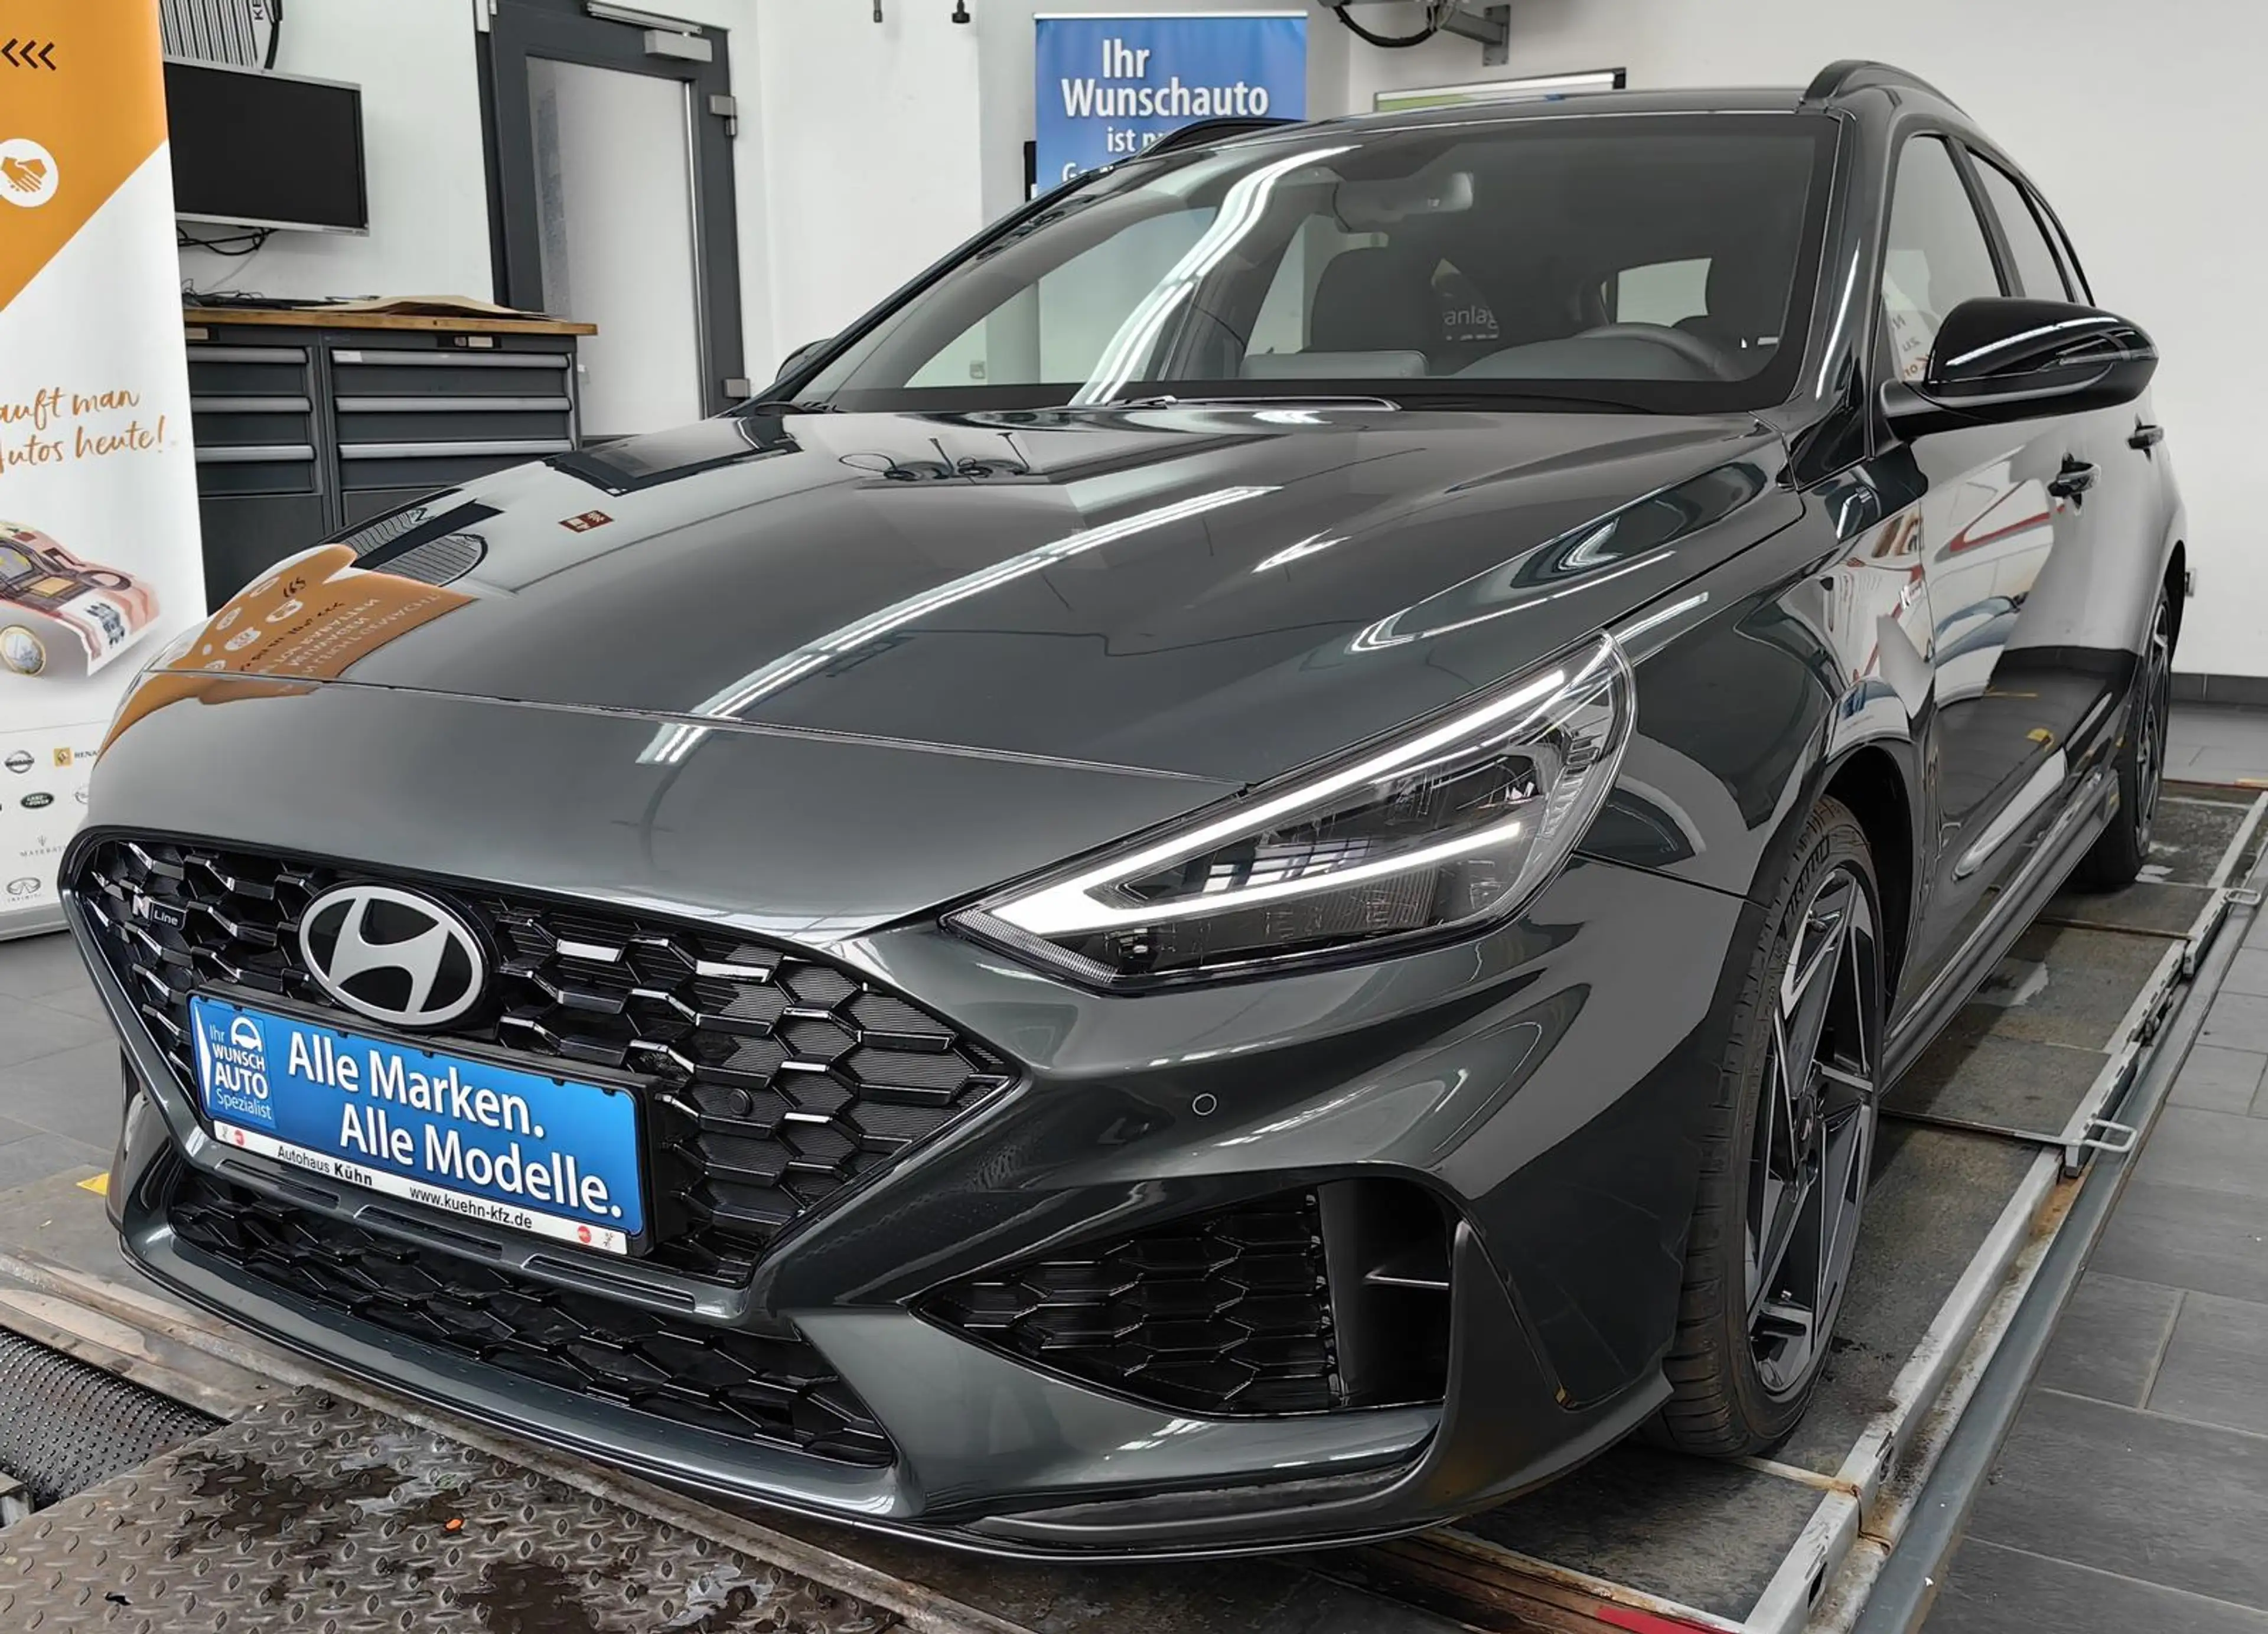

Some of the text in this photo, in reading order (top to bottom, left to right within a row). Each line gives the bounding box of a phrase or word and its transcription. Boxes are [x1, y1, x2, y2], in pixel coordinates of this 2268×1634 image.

[1103, 38, 1150, 78] Ihr
[1061, 77, 1269, 117] Wunschauto
[1107, 126, 1136, 152] ist
[72, 390, 139, 415] man
[75, 415, 165, 458] heute!
[154, 909, 178, 926] Line
[210, 1024, 225, 1043] Ihr
[213, 1043, 265, 1071] WUNSCH
[215, 1061, 269, 1100] AUTO
[288, 1031, 545, 1139] Alle Marken.
[216, 1088, 272, 1120] Spezialist
[277, 1146, 373, 1186] Autohaus Kühn
[340, 1103, 623, 1218] Alle Modelle.
[409, 1186, 532, 1228] www.kuehn-kfz.de
